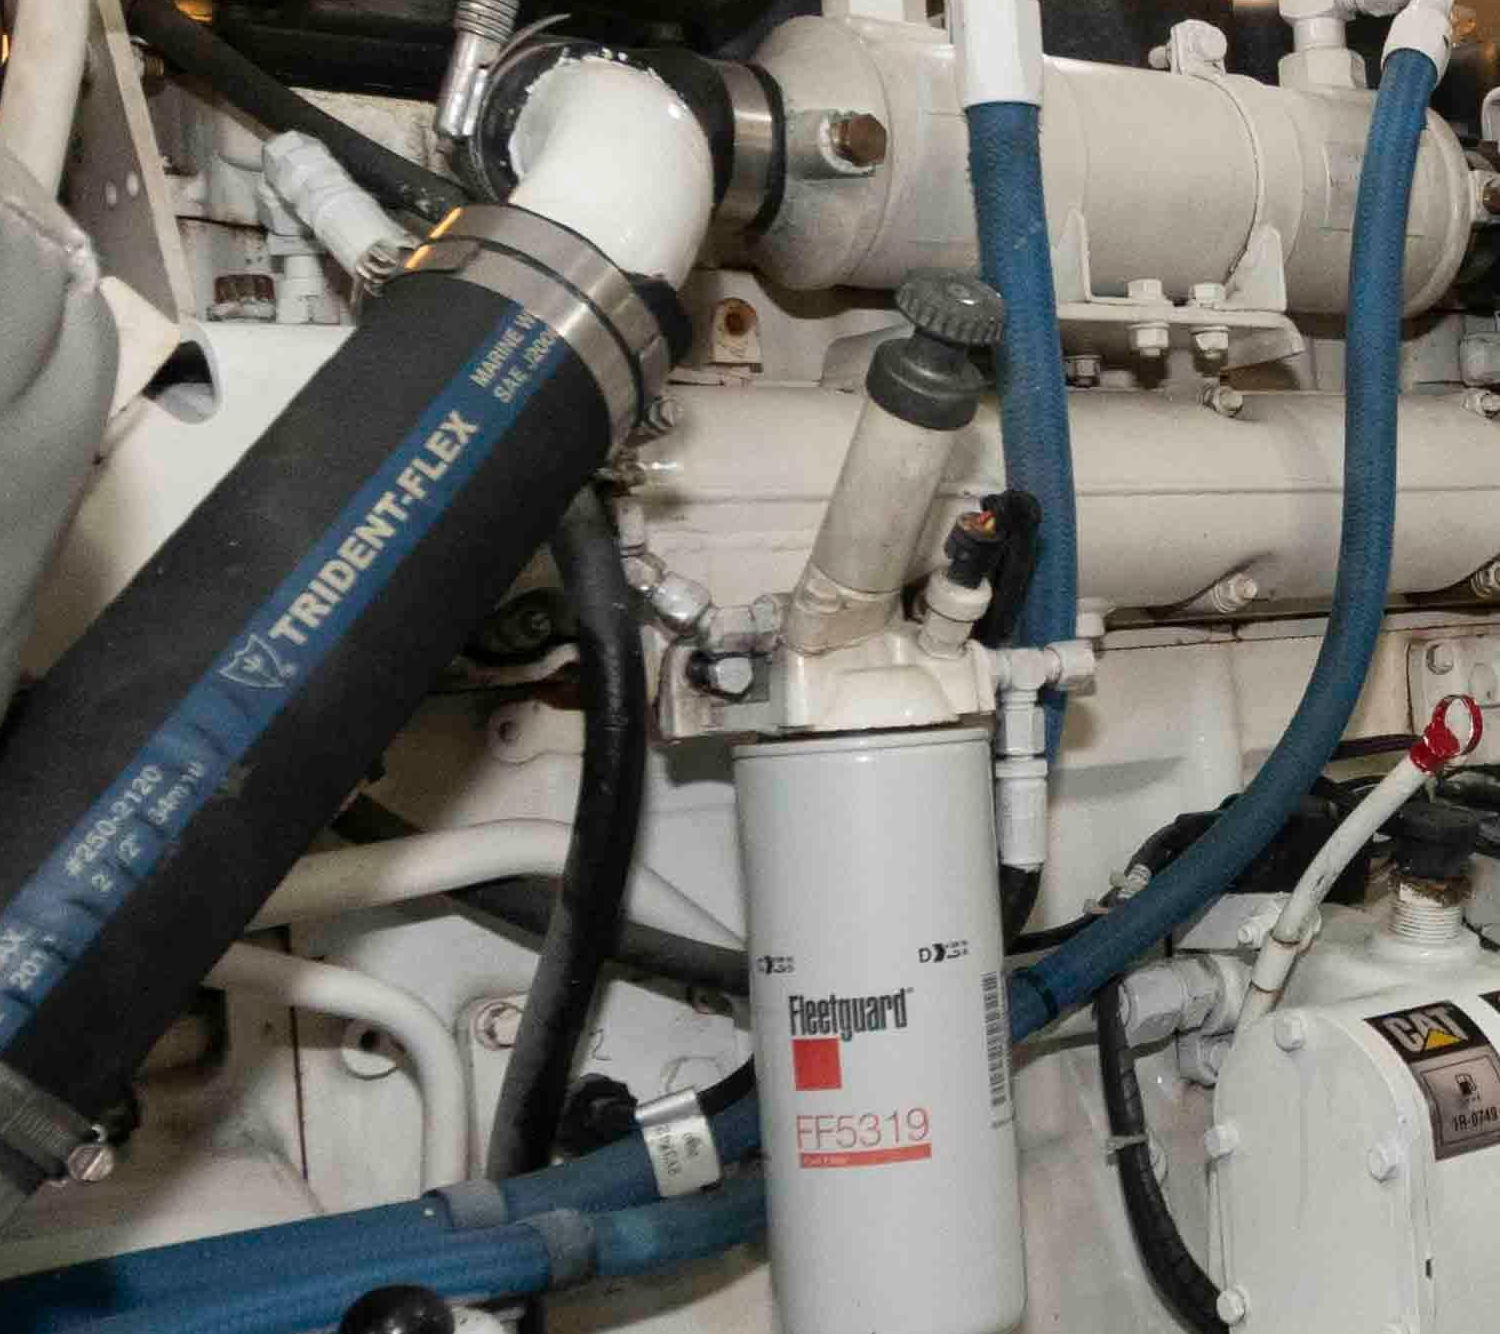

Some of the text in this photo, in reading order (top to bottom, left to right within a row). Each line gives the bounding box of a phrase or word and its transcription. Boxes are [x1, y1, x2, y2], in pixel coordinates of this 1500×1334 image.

[469, 327, 526, 388] MARINE
[492, 365, 528, 404] SAE
[268, 410, 480, 646] TRIDENT-FLEX
[66, 764, 163, 876] #250-2120
[788, 987, 908, 1042] Fleetguard
[1382, 1006, 1469, 1053] CAT
[796, 1107, 930, 1150] FF5319
